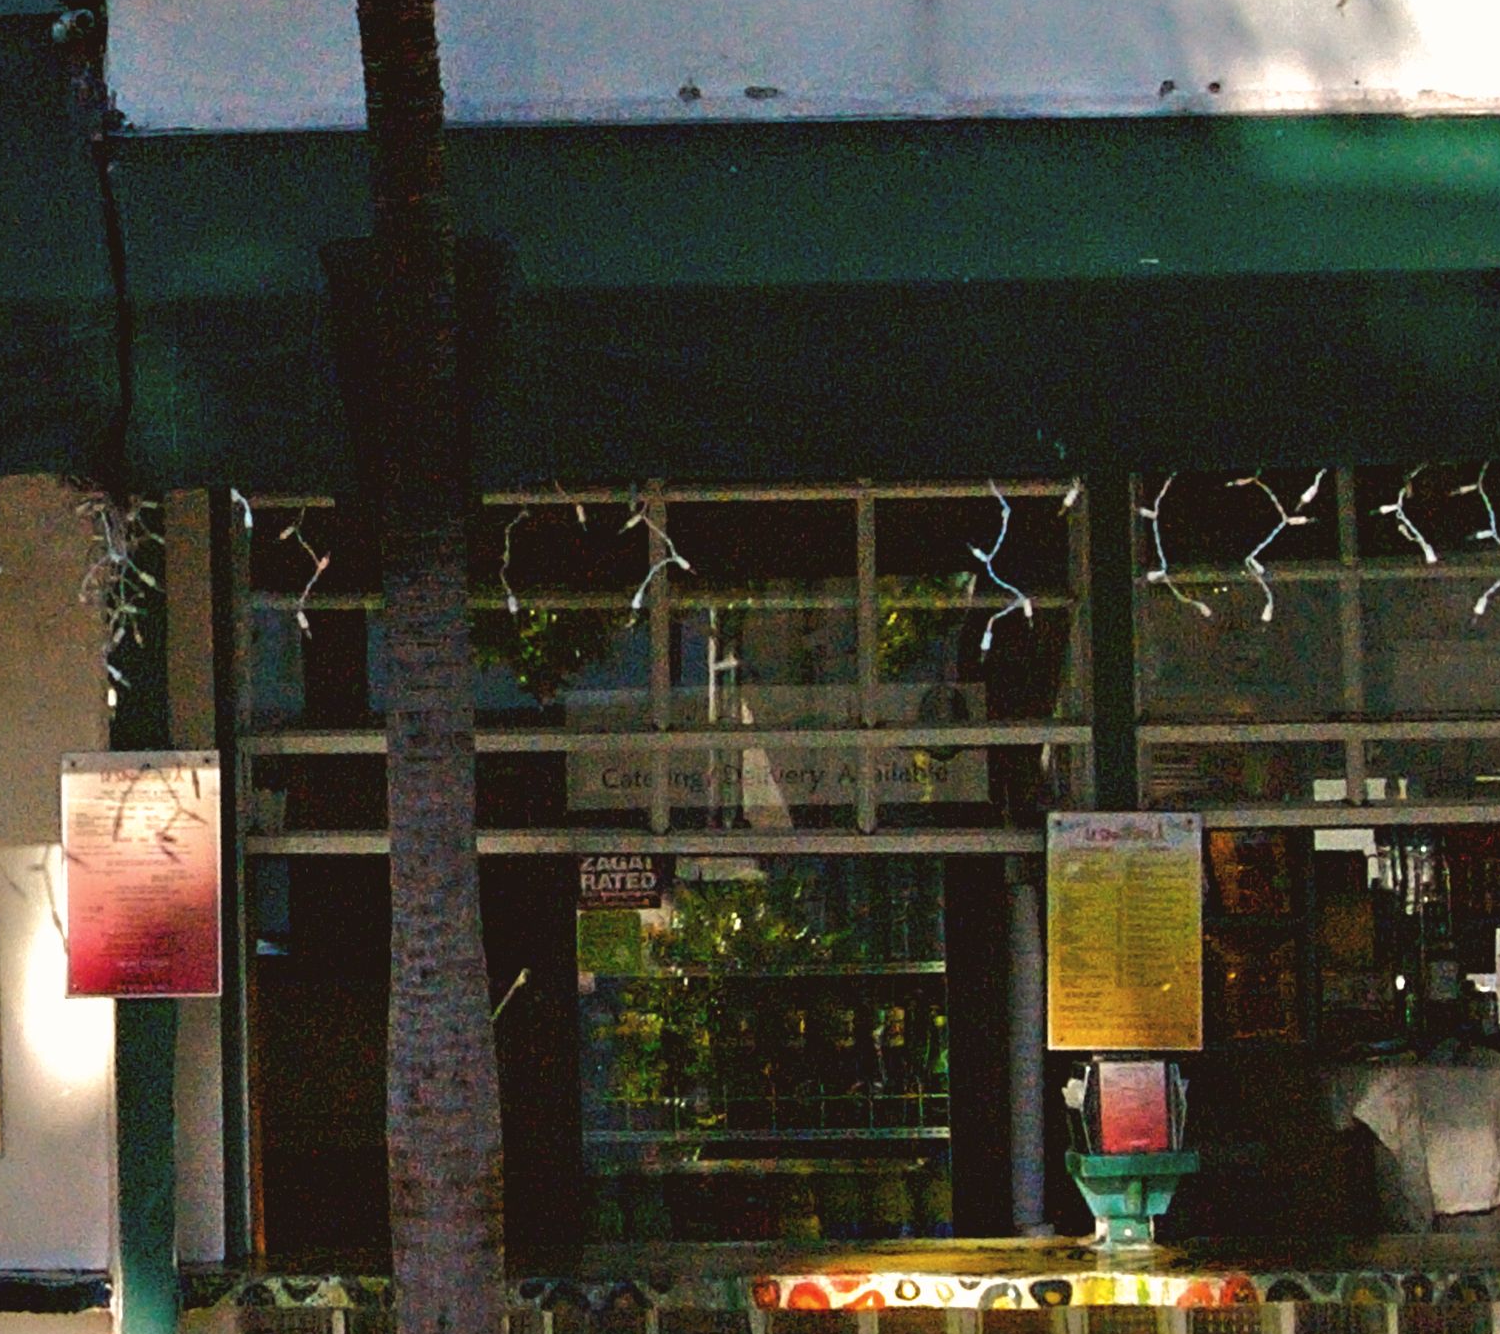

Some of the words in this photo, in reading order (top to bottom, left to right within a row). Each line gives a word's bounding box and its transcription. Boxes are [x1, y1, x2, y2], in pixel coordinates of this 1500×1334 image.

[601, 765, 704, 793] Cateing
[837, 763, 949, 785] Aailable
[580, 872, 657, 891] RATED
